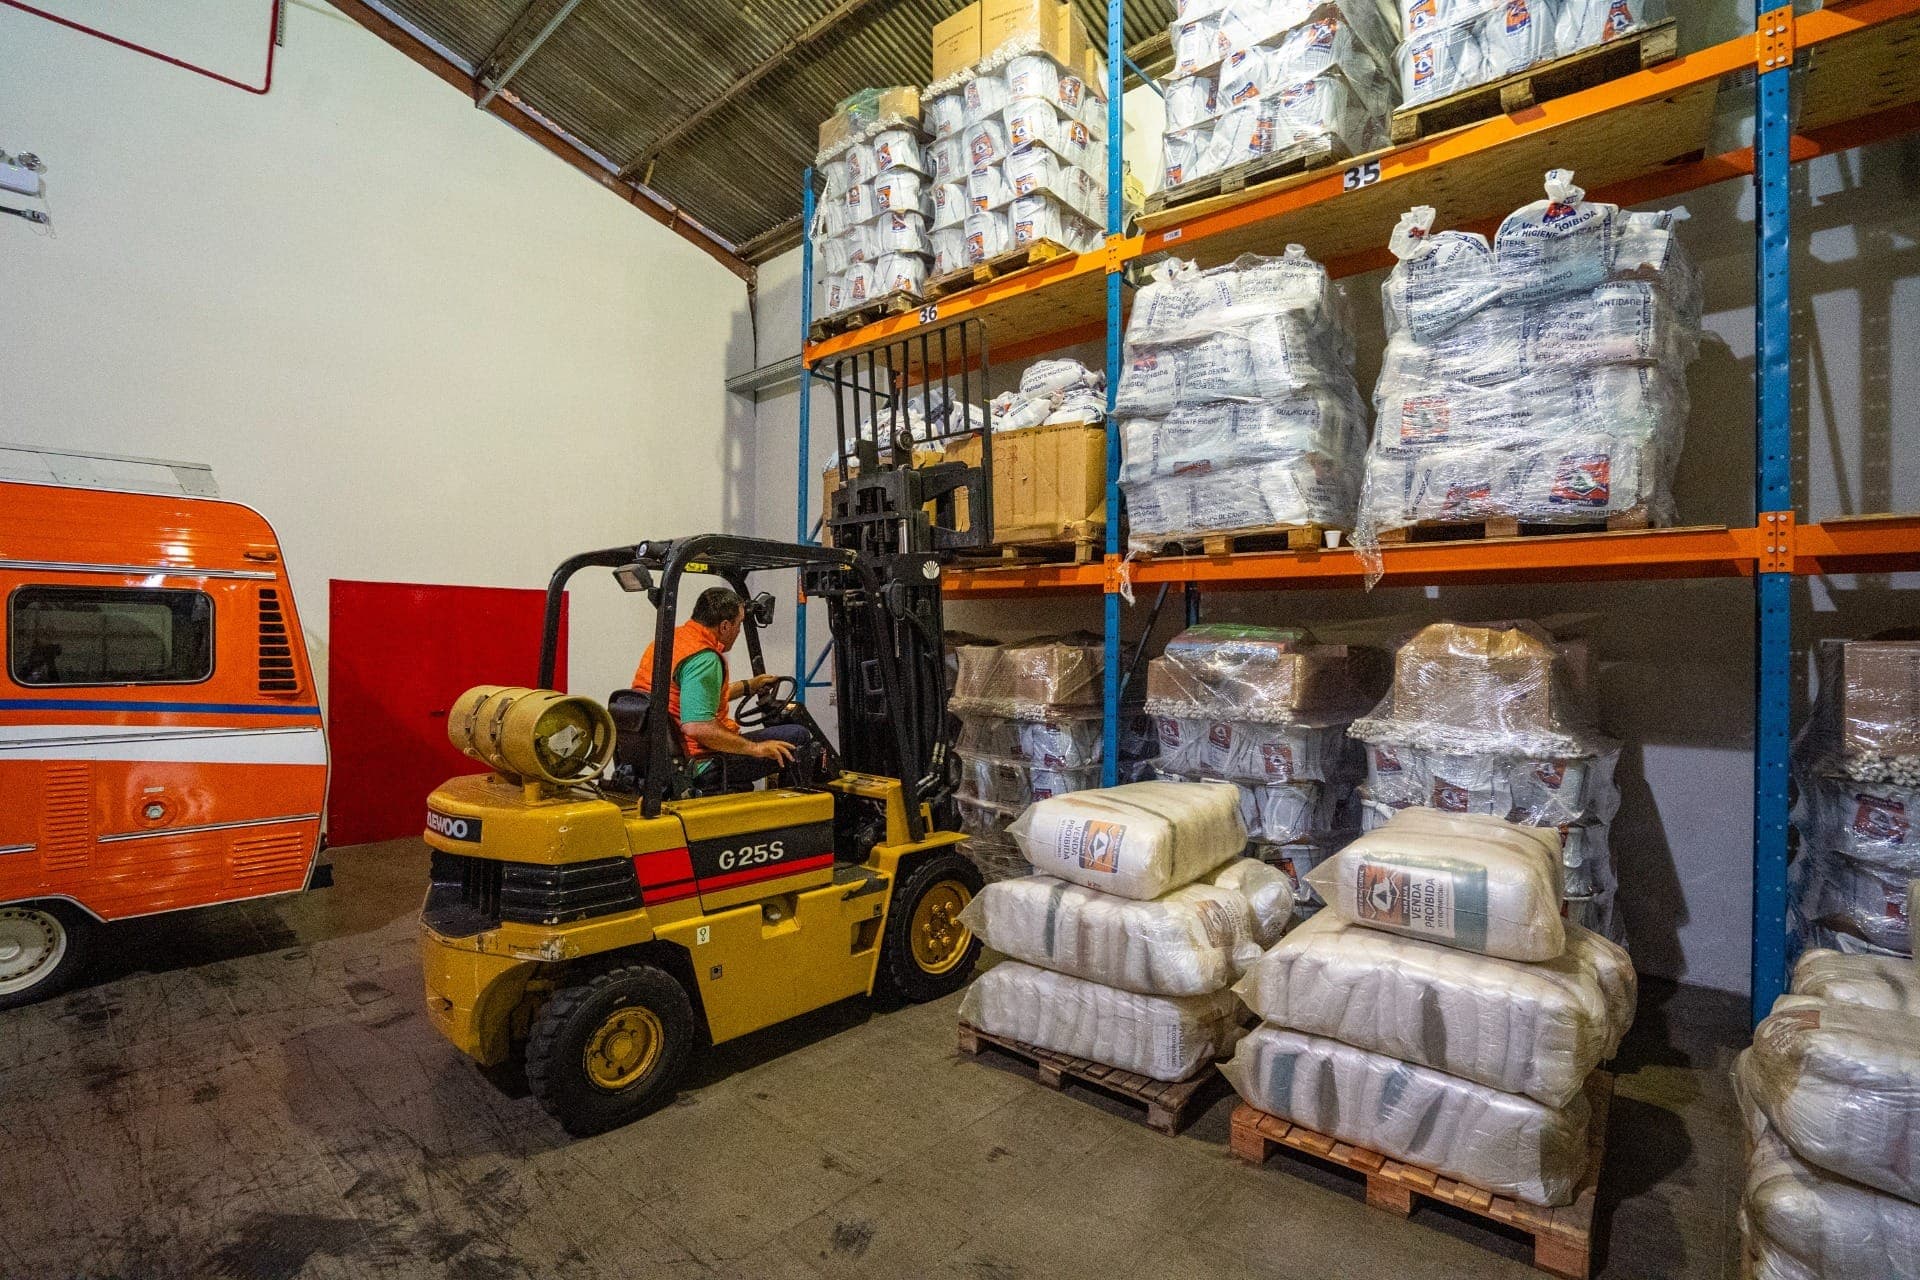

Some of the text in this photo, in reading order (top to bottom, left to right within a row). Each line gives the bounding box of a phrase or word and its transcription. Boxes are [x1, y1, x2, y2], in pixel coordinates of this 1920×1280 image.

[1344, 160, 1380, 191] 35
[920, 304, 937, 324] 36
[1063, 819, 1076, 860] PROIBIDA
[1411, 883, 1422, 919] VENDA
[1424, 878, 1435, 929] PROIBIDA
